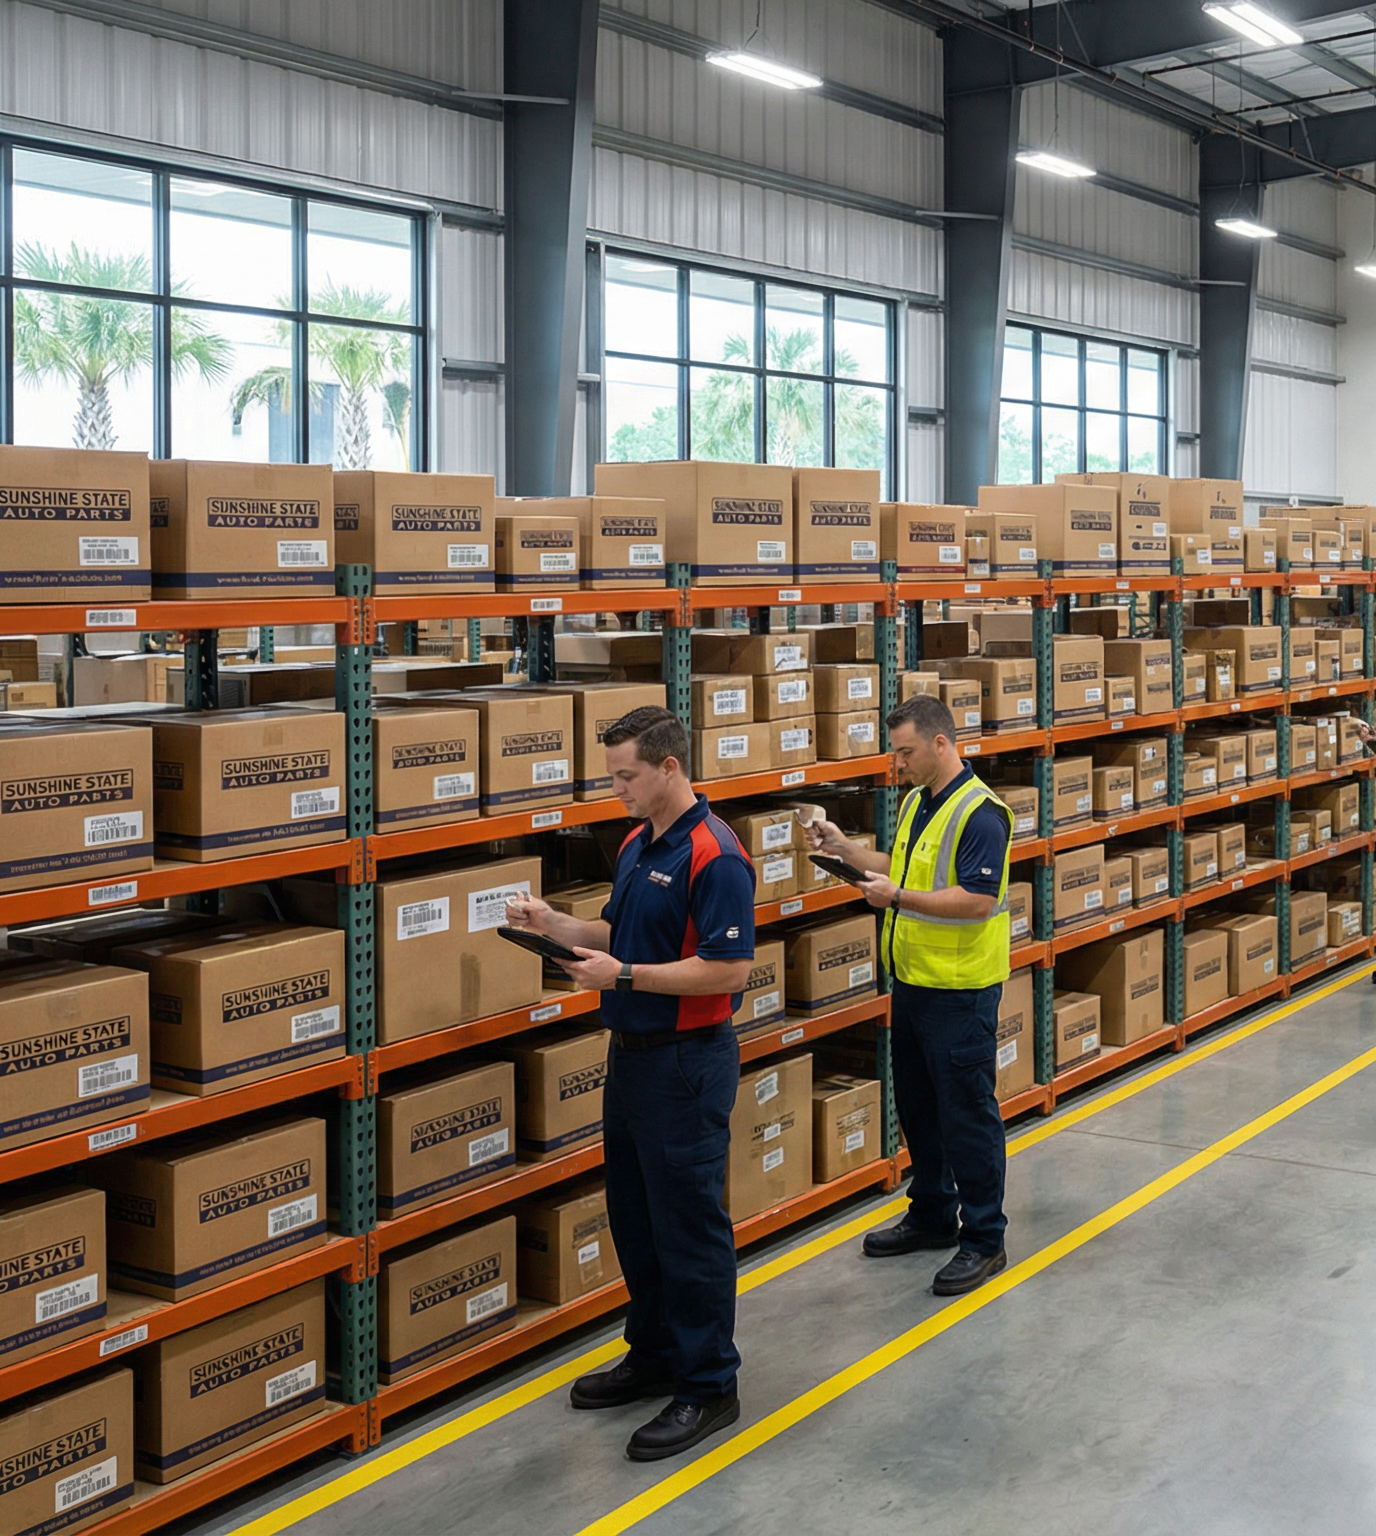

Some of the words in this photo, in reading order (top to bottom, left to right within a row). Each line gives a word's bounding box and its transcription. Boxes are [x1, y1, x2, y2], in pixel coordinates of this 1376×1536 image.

[0, 490, 78, 506] SUNSHINE
[82, 492, 127, 508] STATE
[280, 503, 317, 515] STATE
[4, 508, 56, 518] AUTO
[66, 509, 123, 520] PARTS
[224, 757, 289, 776] SUNSHINE
[291, 753, 327, 768] STATE
[6, 778, 82, 798] SUNSHINE
[86, 772, 130, 790] STATE
[10, 796, 61, 812] AUTO
[292, 973, 327, 991] STATE
[229, 1001, 271, 1020] AUTO
[0, 1031, 78, 1060] SUNSHINE
[82, 1019, 126, 1041] STATE
[6, 1053, 56, 1074] AUTO
[65, 1037, 122, 1059] PARTS
[270, 1163, 307, 1184] STATE
[205, 1198, 250, 1220] AUTO
[34, 1240, 81, 1266] STATE
[197, 1368, 242, 1394] AUTO
[57, 1423, 102, 1454] STATE
